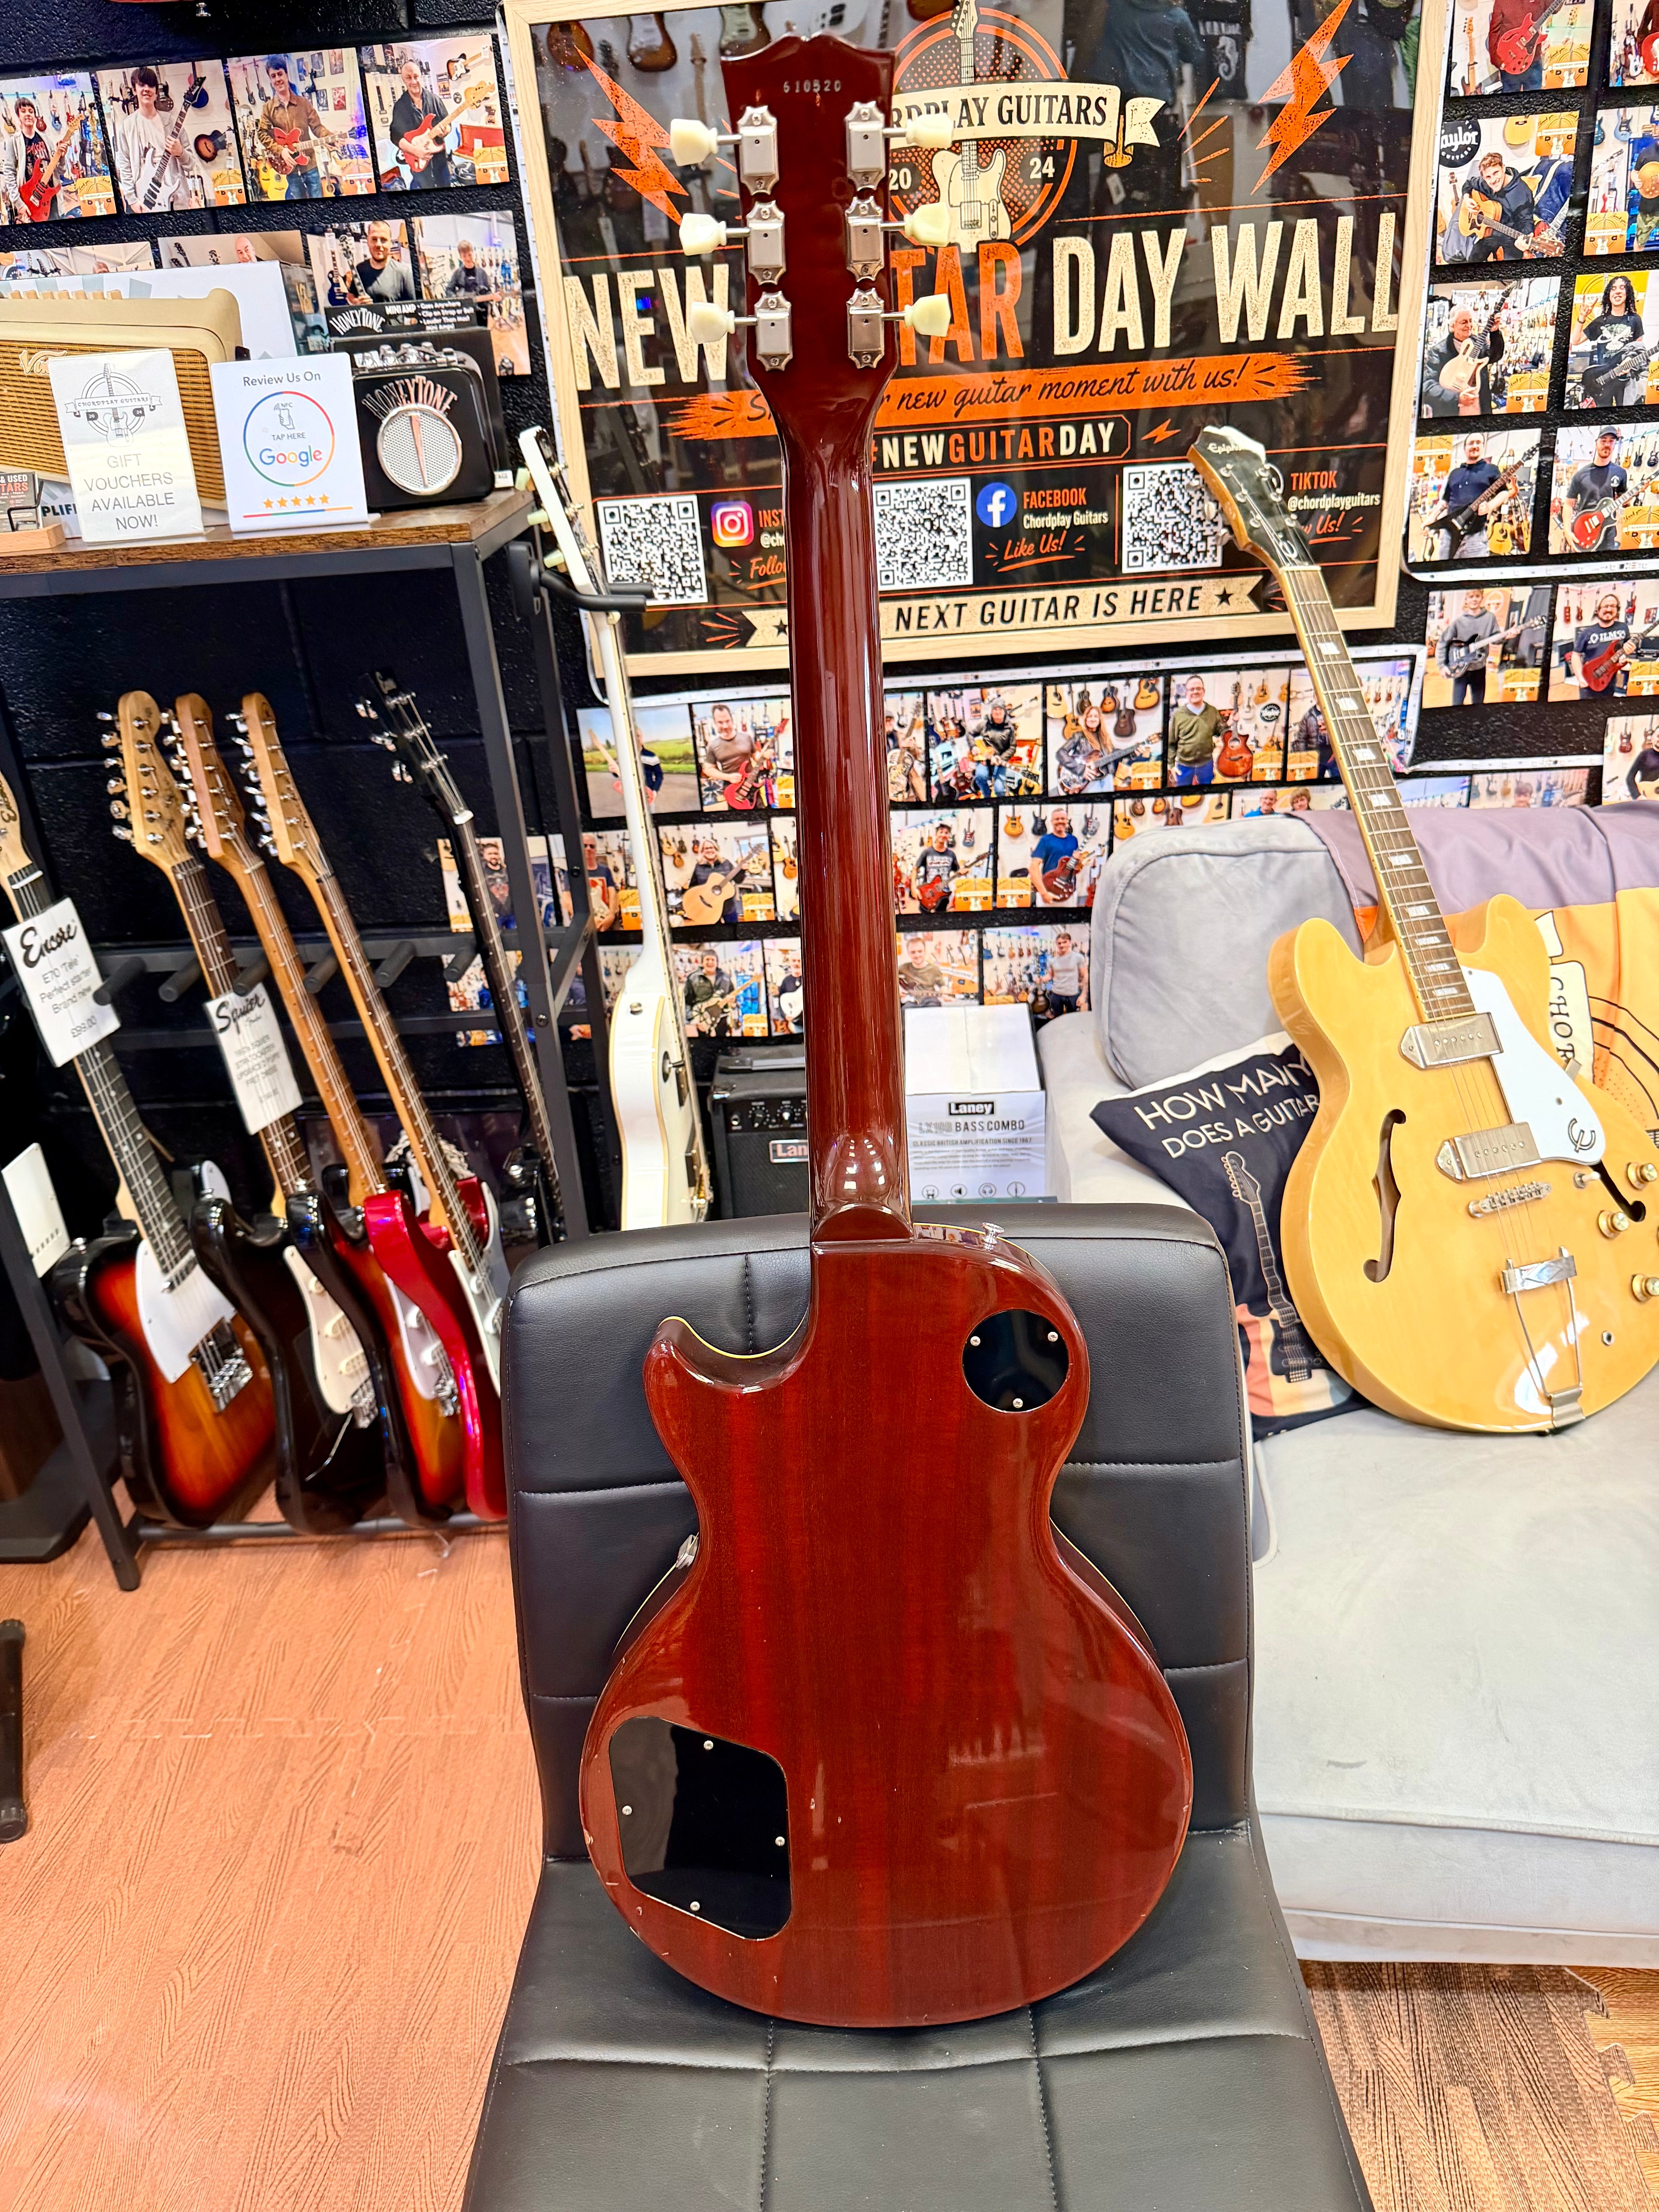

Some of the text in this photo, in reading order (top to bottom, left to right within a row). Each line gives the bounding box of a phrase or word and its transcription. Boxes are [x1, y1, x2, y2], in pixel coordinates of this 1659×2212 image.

[783, 79, 842, 93] 610520
[998, 95, 1107, 126] GUITARS
[1441, 127, 1478, 151] aylor
[890, 156, 1055, 190] 20 24
[563, 264, 729, 390] NEW
[1053, 228, 1187, 356] DAY
[1211, 213, 1398, 343] WALL
[329, 307, 386, 335] HONEYTONE
[243, 371, 321, 386] Review Us On
[896, 389, 947, 411] new
[953, 375, 1032, 419] guitar
[1037, 366, 1139, 401] moment
[1142, 359, 1197, 393] with
[1203, 356, 1251, 388] us!
[361, 375, 458, 421] HONEYTONE
[107, 453, 141, 468] GIFT
[259, 445, 322, 467] Google
[7, 474, 27, 483] USED
[84, 472, 173, 491] VOUCHERS
[1290, 471, 1338, 491] TIKTOK
[92, 492, 175, 512] AVAILABLE
[1023, 488, 1086, 509] FACEBOOK
[1288, 491, 1381, 512] @chordplayguitars
[115, 514, 158, 530] NOW!
[1023, 510, 1109, 532] Chordplay Guitars
[1316, 511, 1345, 535] Us!
[1003, 531, 1067, 561] Like Us!
[895, 586, 1202, 632] NEXT GUITAR IS HERE
[21, 924, 77, 968] Encore
[40, 967, 92, 1003] Perfect starter
[42, 968, 60, 984] E70
[52, 986, 92, 1014] Brand new
[216, 994, 265, 1035] Squier
[1133, 1053, 1313, 1130] HOW MANY
[950, 1103, 993, 1115] Laney
[918, 1120, 1025, 1134] LX10B BASS COMBO
[1161, 1094, 1320, 1159] DOES A GUITAR
